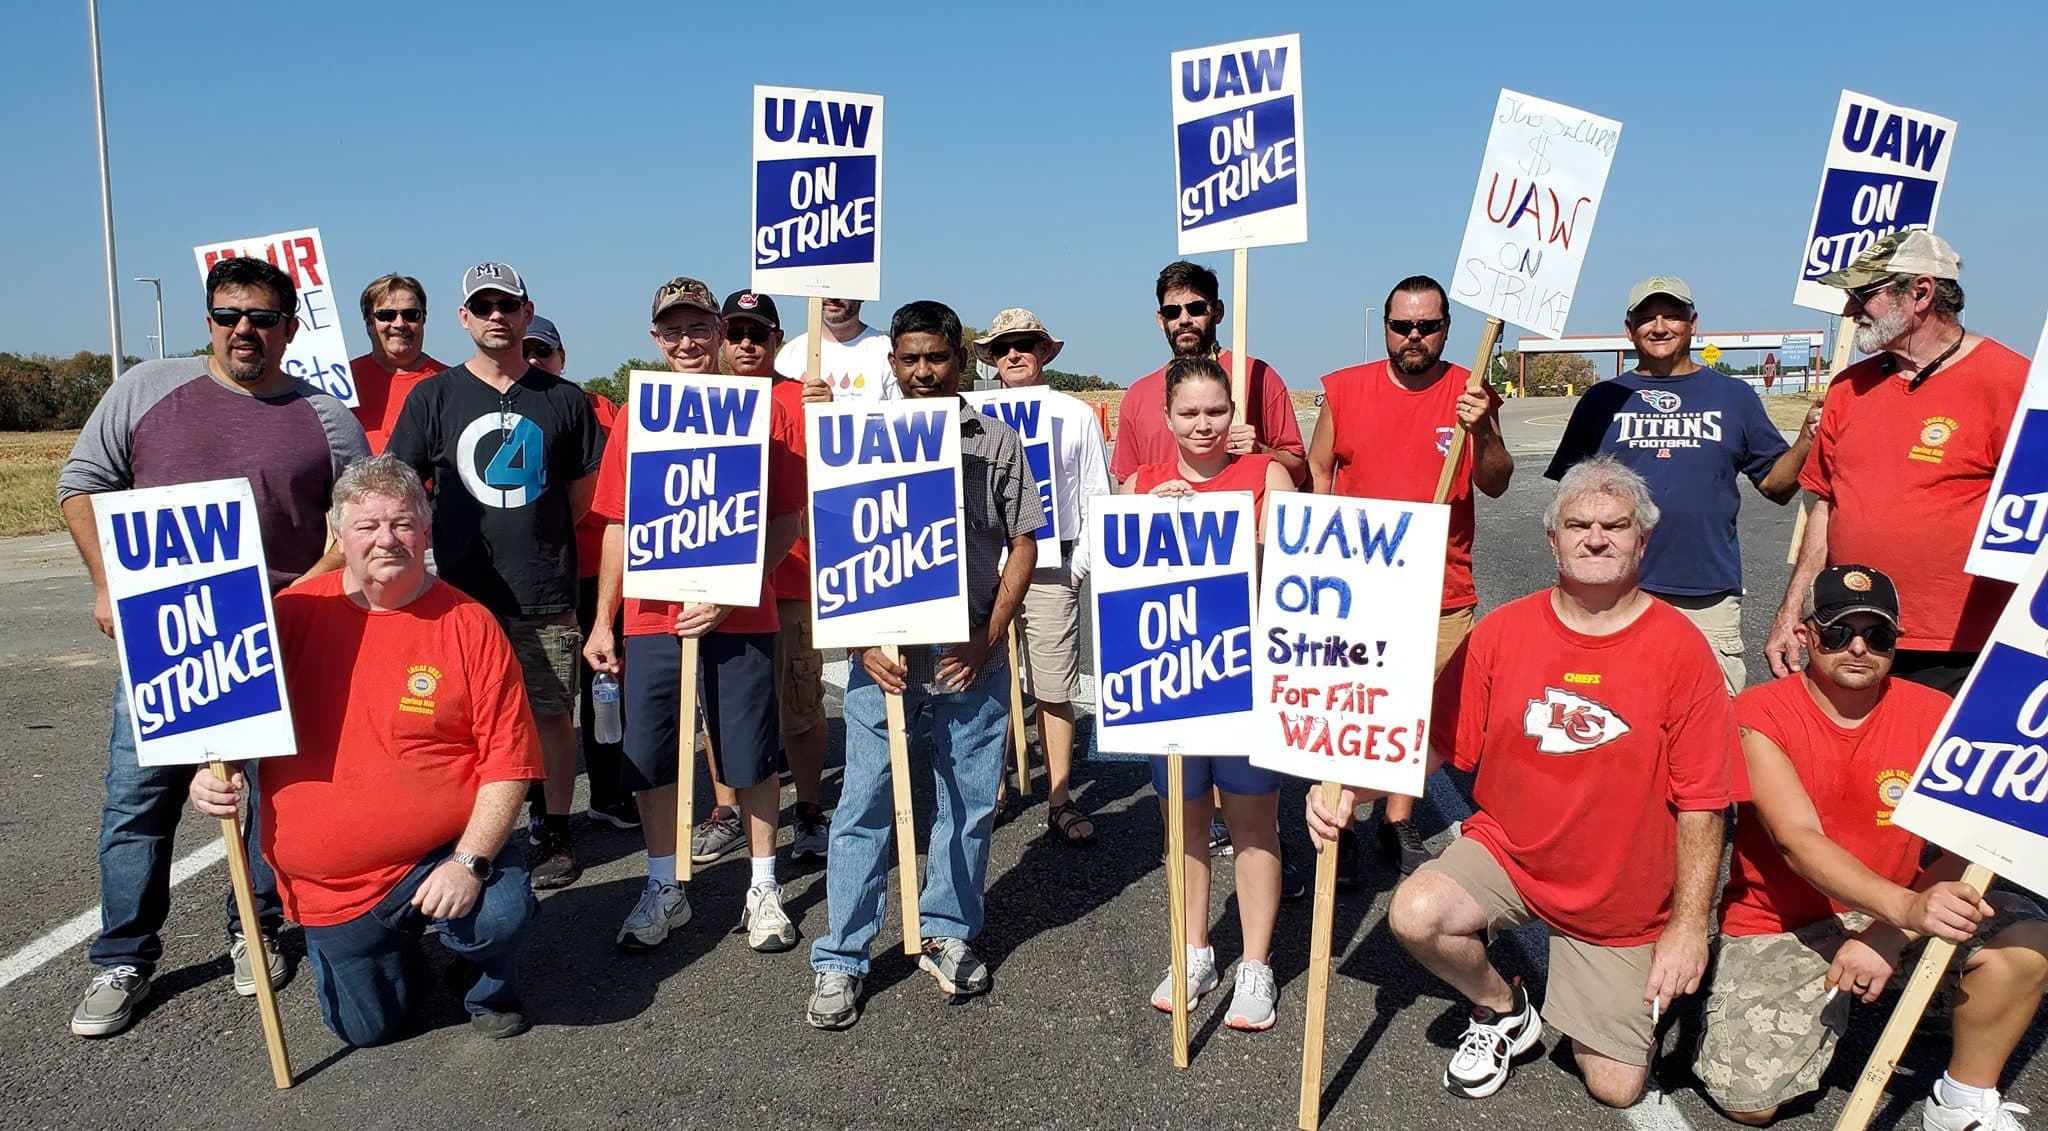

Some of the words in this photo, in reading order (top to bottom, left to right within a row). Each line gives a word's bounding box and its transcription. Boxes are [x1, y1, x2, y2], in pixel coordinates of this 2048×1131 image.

[1182, 47, 1288, 103] UAW
[764, 96, 873, 149] UAW
[1209, 110, 1255, 165] ON
[1842, 103, 1946, 173] UAW
[790, 161, 837, 211] ON
[1182, 137, 1296, 227] STRIKE
[1851, 180, 1903, 225] ON
[757, 195, 875, 265] STRIKE
[1487, 172, 1592, 250] UAW
[1500, 242, 1542, 278] ON
[667, 282, 692, 296] M
[1457, 258, 1570, 333] STRIKE
[638, 382, 759, 438] UAW
[1613, 410, 1722, 442] TITANS
[818, 410, 947, 467] UAW
[1629, 439, 1701, 449] FOOTBALL
[664, 453, 716, 504] ON
[111, 501, 242, 571] UAW
[629, 489, 759, 567] STRIKE
[852, 489, 908, 544] ON
[1103, 510, 1239, 568] UAW
[1277, 504, 1413, 568] U.A.W.
[817, 517, 958, 615] STRIKE
[158, 586, 217, 658] ON
[1139, 586, 1197, 650] ON
[1275, 574, 1353, 620] on
[134, 621, 274, 735] STRIKE
[1102, 624, 1250, 722] STRIKE
[1270, 674, 1321, 709] For
[1564, 672, 1602, 684] CHIEFS
[1279, 710, 1426, 765] WAGES!
[1548, 703, 1605, 744] KC
